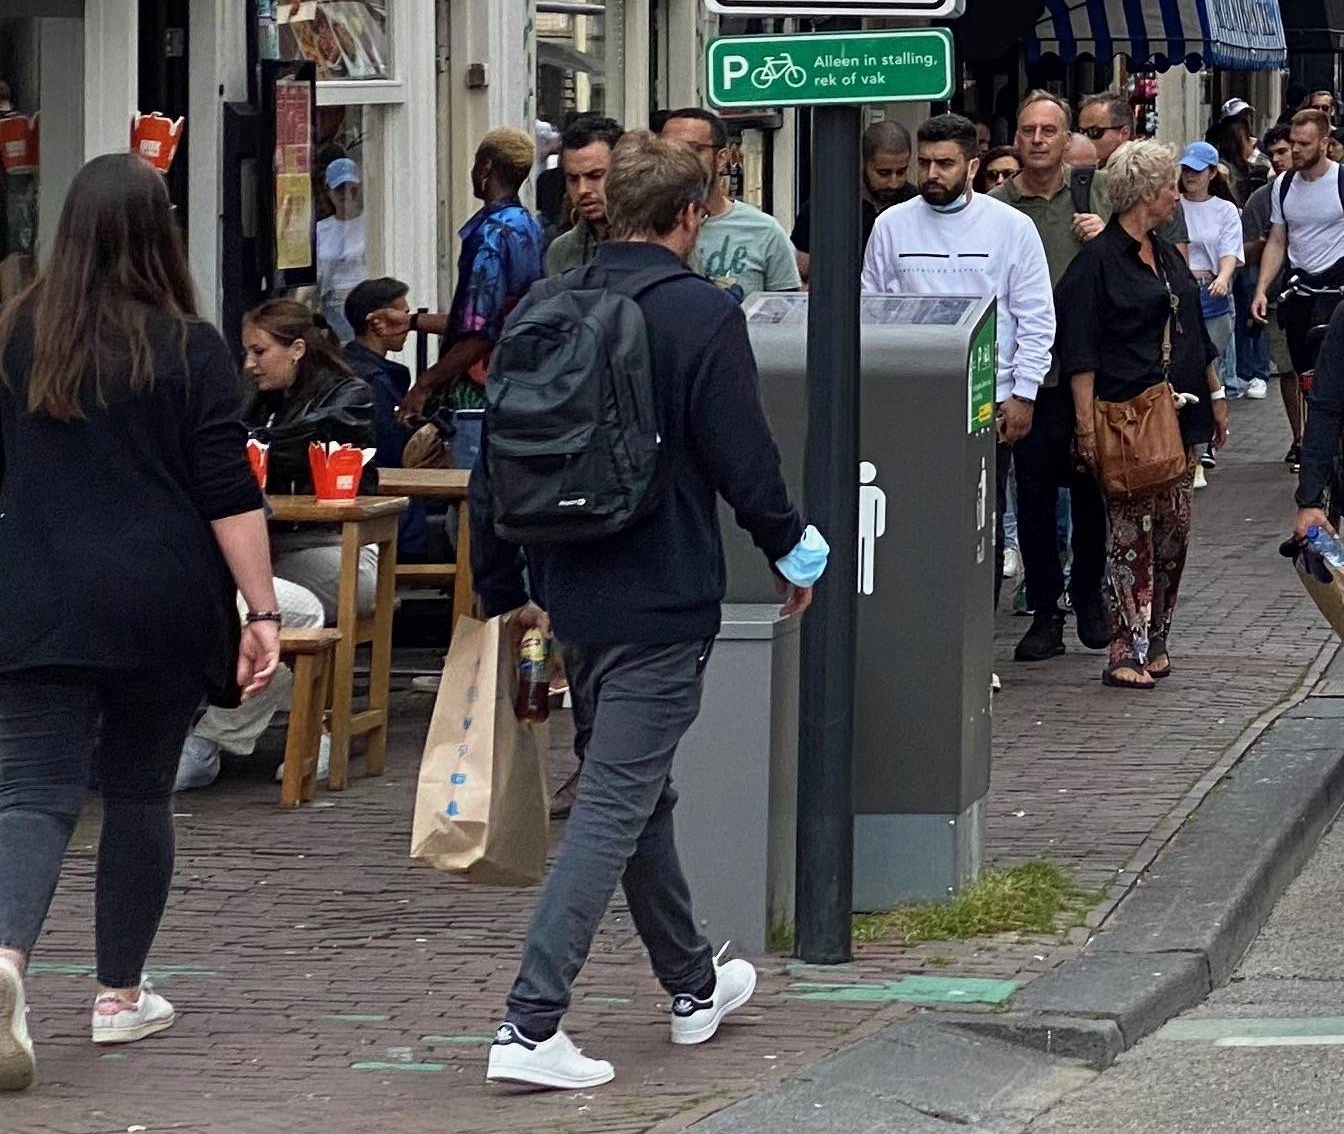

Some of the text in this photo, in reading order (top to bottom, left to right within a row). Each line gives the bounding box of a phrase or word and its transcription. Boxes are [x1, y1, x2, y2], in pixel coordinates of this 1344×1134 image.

[723, 55, 749, 90] P
[814, 56, 859, 68] Alleen
[864, 54, 877, 66] in
[814, 72, 886, 86] rek of vak
